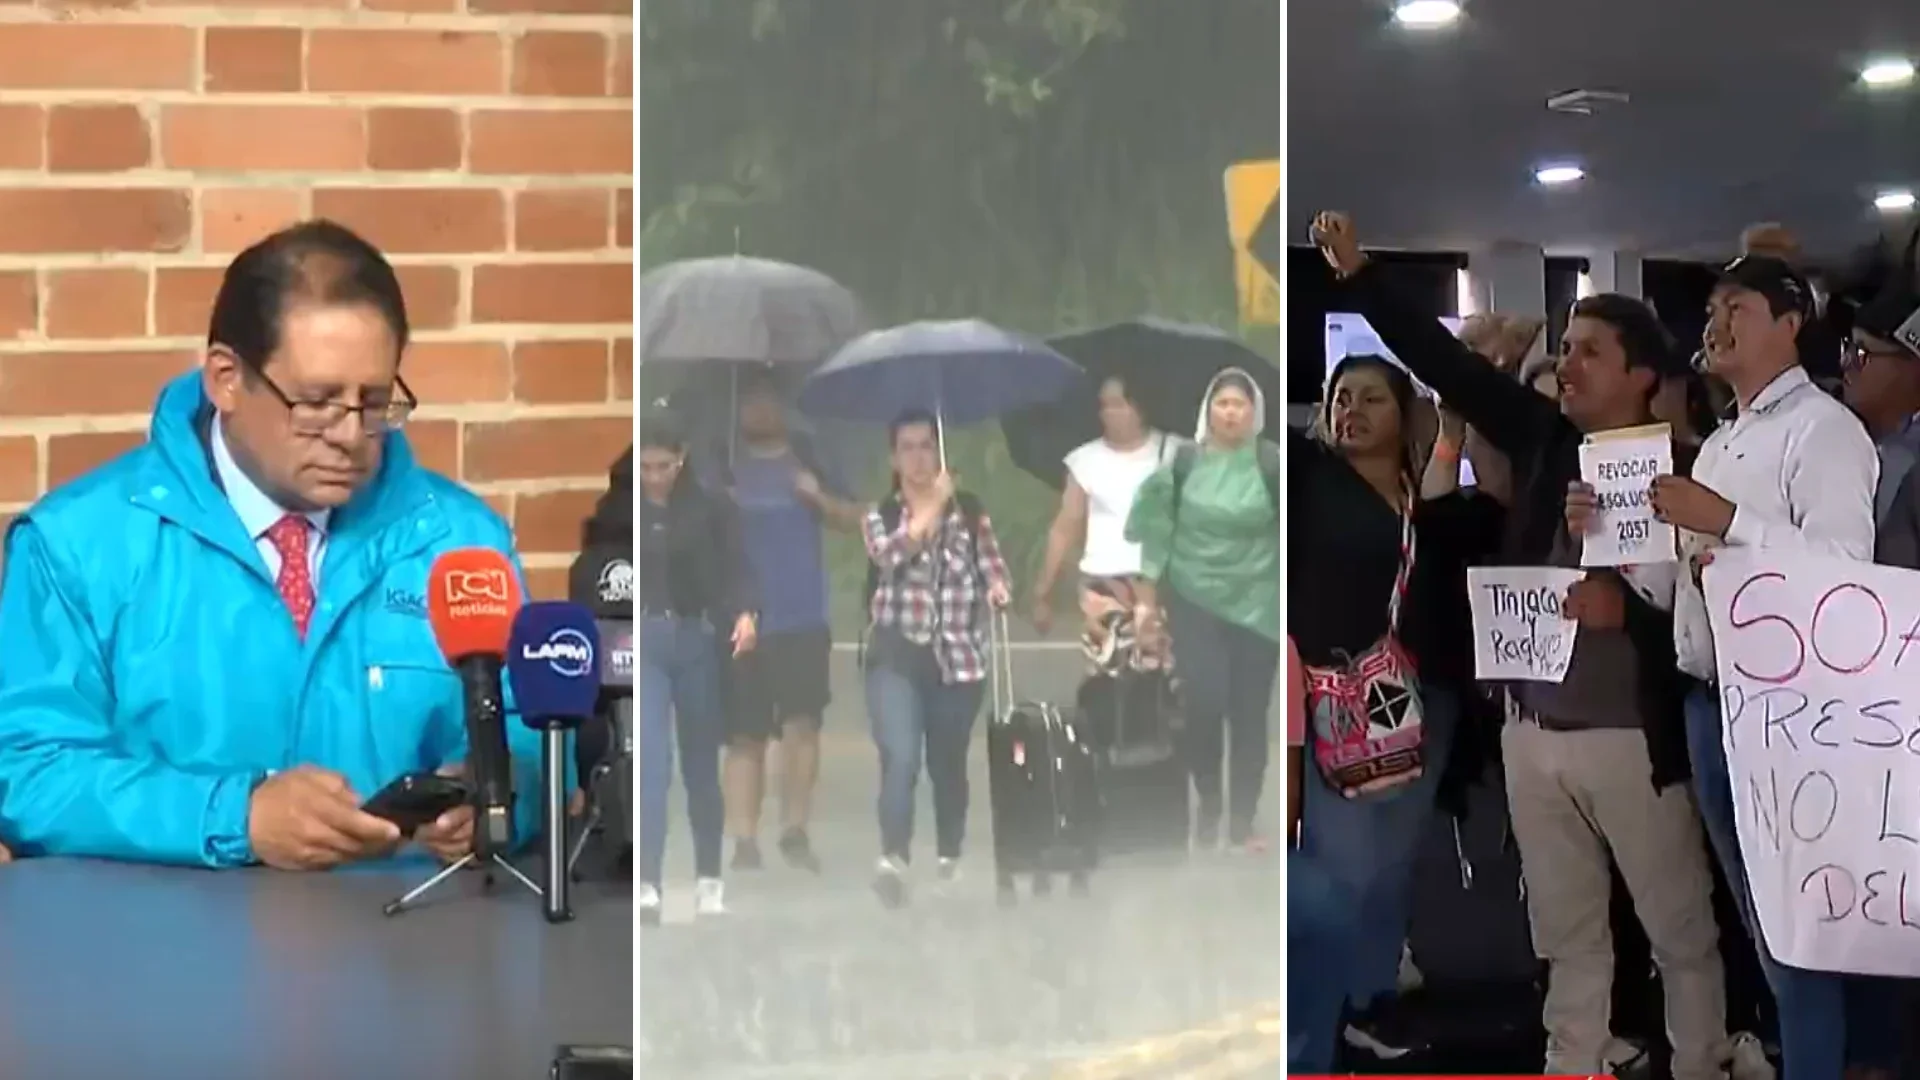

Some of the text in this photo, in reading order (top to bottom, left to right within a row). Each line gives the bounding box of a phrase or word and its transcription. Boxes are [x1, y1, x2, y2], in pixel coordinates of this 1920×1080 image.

[1598, 460, 1657, 480] REVOCAR
[1596, 489, 1647, 510] ESOLUC
[1617, 520, 1649, 541] 2057
[445, 568, 508, 603] RCN
[1750, 767, 1838, 852] NO
